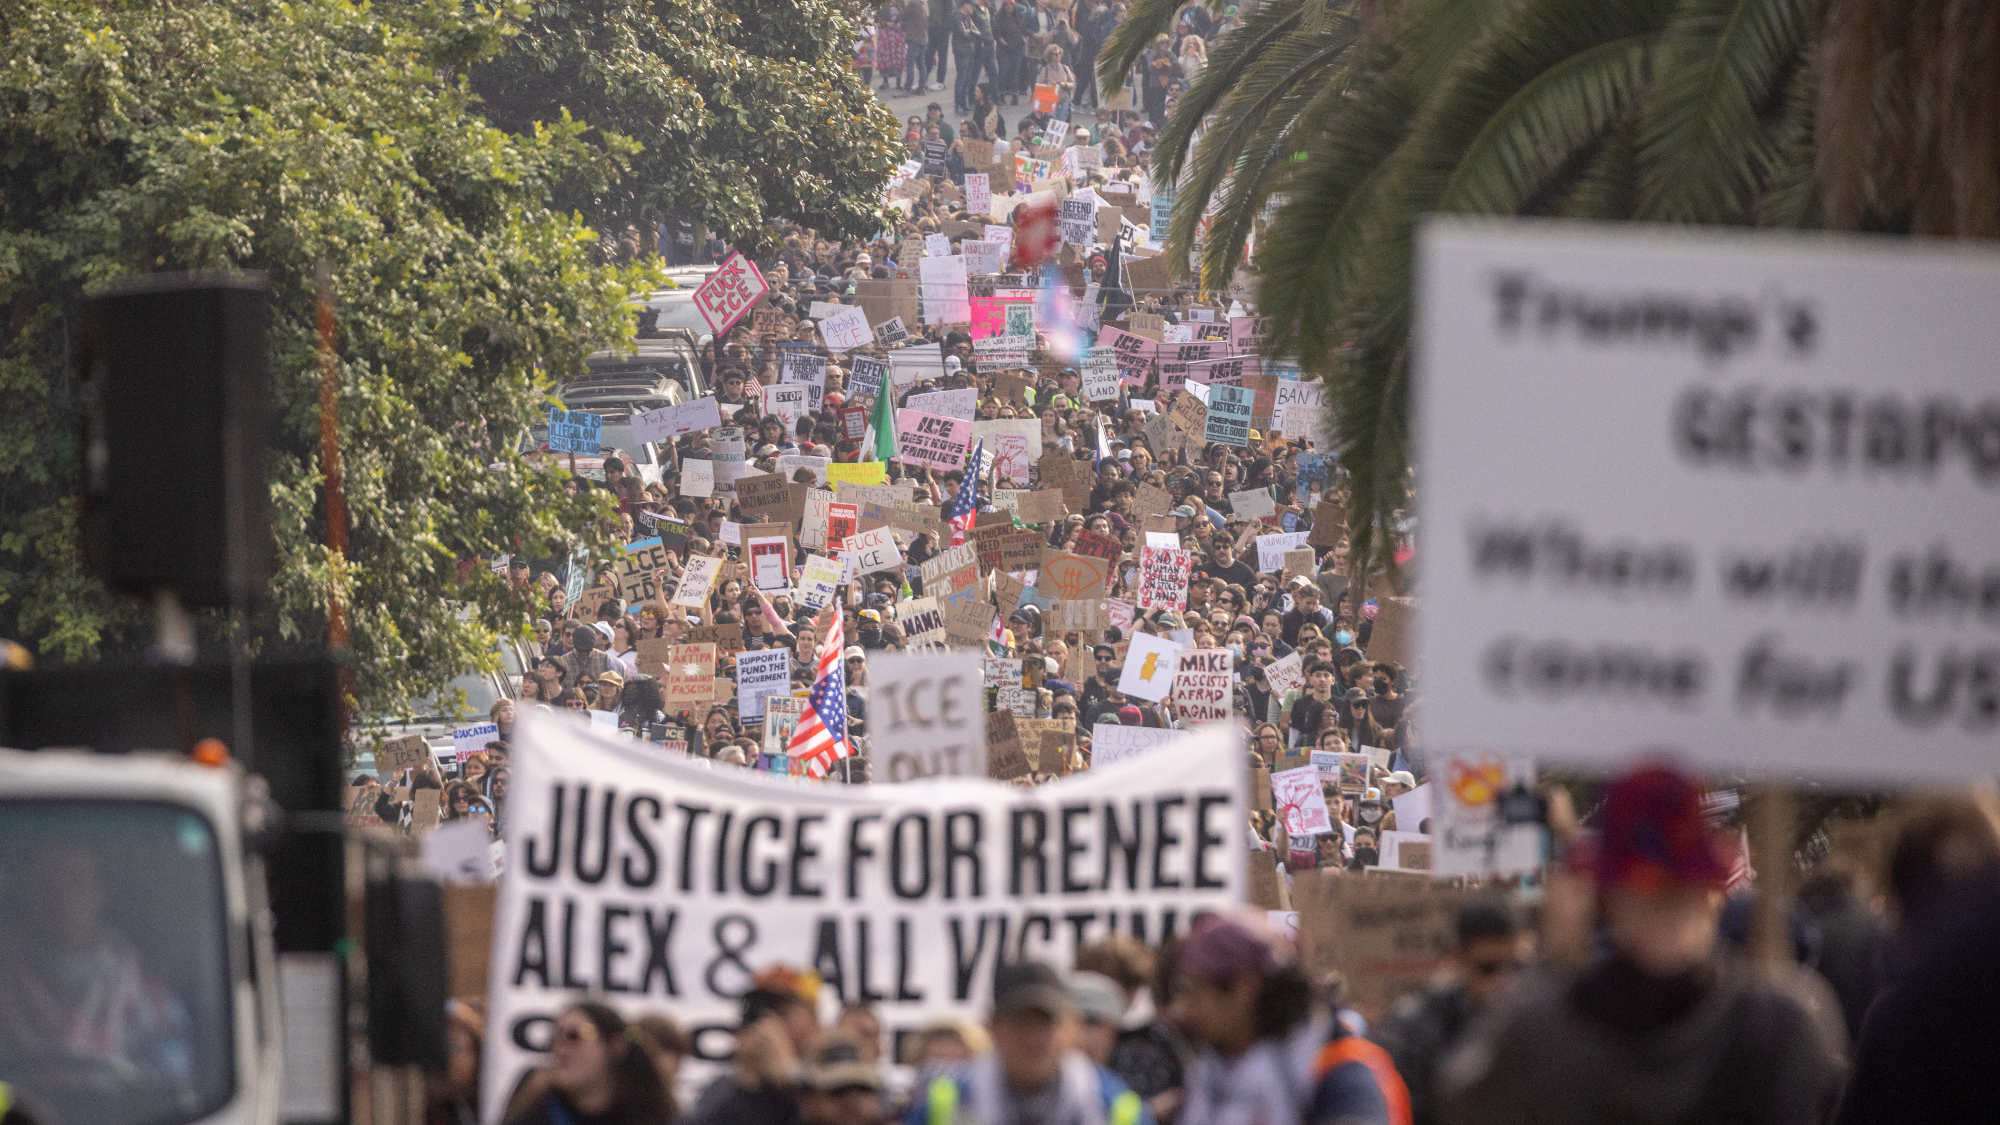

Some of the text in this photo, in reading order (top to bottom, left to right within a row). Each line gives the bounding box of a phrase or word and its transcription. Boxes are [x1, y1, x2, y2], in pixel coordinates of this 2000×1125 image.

[1015, 156, 1049, 178] FUCK
[967, 175, 987, 186] THIS
[972, 185, 980, 193] IS
[968, 193, 989, 201] STATE
[967, 203, 991, 212] VIOLENCE
[1063, 200, 1092, 215] DEFEND
[1062, 211, 1091, 222] DEMOCRACY:
[1062, 223, 1073, 231] IT'S
[1073, 223, 1084, 232] TIME
[1068, 237, 1086, 245] STRIKE!
[1069, 230, 1088, 239] GENERAL
[965, 244, 996, 255] ABOLISH
[965, 257, 983, 266] ICE
[700, 260, 746, 311] FUCK
[713, 279, 753, 325] ICE
[754, 311, 782, 323] FUCK
[1487, 266, 1817, 366] Trump's
[758, 322, 783, 333] ICE
[825, 314, 860, 337] Abolish
[885, 321, 901, 334] OUT
[1132, 316, 1150, 330] FUCK
[887, 330, 907, 343] GOOD!
[1196, 325, 1230, 340] ICE
[833, 327, 865, 352] ICE
[1008, 337, 1016, 345] DO
[1114, 333, 1145, 354] ICE
[786, 353, 825, 366] IT'S TIME FOR
[1177, 346, 1211, 361] ICE
[793, 364, 820, 375] GENERAL
[854, 358, 887, 378] DEFEN
[1084, 358, 1112, 370] ILLEGAL
[1208, 361, 1243, 380] ICE
[792, 371, 816, 382] STRIKE!
[1085, 374, 1117, 386] STOLEN
[849, 381, 874, 394] IT'S TIME
[1089, 386, 1116, 398] LAND
[776, 391, 802, 402] STOP
[910, 395, 937, 405] JESUS
[1278, 387, 1308, 405] BAN
[1210, 401, 1251, 416] JUSTICE FOR
[551, 408, 602, 428] NO ONE IS
[1208, 416, 1249, 428] RENEE
[550, 423, 597, 441] ILLEGAL ON
[916, 416, 955, 438] ICE
[1206, 424, 1248, 438] NICOLE GOOD
[899, 431, 966, 454] DESTROYS
[1671, 384, 2000, 488] GESTAPO
[551, 437, 601, 455] STOLEN LAND
[900, 444, 961, 465] FAMILIES
[738, 484, 758, 496] FUCK
[762, 479, 782, 491] THIS
[757, 490, 789, 507] BULLSHIT!
[855, 490, 894, 501] PRISON
[994, 491, 1017, 500] ENOU
[895, 499, 921, 513] HATE
[657, 519, 689, 536] EXISTENCE
[832, 519, 851, 529] JAIL
[834, 528, 848, 538] ICE
[845, 531, 883, 553] FUCK
[976, 539, 1000, 552] NEED
[1023, 542, 1040, 550] DUE
[753, 544, 783, 556] STOP
[1003, 550, 1036, 559] PROCESS
[618, 546, 667, 578] ICE
[858, 551, 884, 570] ICE
[922, 561, 939, 584] OPEN
[938, 549, 958, 574] YOUR
[957, 541, 976, 569] EYES
[1156, 553, 1171, 565] NO
[1468, 517, 1698, 586] When
[1722, 536, 1866, 606] will
[1145, 563, 1180, 573] HUMAN
[938, 574, 952, 597] WAS
[952, 567, 978, 592] MURDER
[1144, 580, 1183, 590] ON STOLEN
[588, 590, 610, 600] THE
[626, 581, 656, 605] ID
[804, 592, 826, 604] ICE
[1149, 591, 1177, 601] LAND
[961, 601, 993, 619] FIGHT
[688, 628, 719, 641] FUCK
[672, 652, 713, 664] ANTIFA
[739, 653, 786, 666] SUPPORT &
[1179, 653, 1228, 673] MAKE
[741, 663, 786, 675] FUND THE
[1267, 664, 1280, 675] WE
[1268, 661, 1302, 683] PROTECT
[1484, 638, 1706, 714] come
[1738, 634, 1858, 716] for
[740, 672, 787, 685] MOVEMENT
[1176, 674, 1229, 688] FASCISTS
[1277, 676, 1289, 686] US
[671, 684, 713, 694] FASCISM
[1000, 689, 1026, 699] STOP
[1177, 689, 1224, 705] AFRAID
[770, 697, 806, 713] MELT
[880, 676, 966, 732] ICE
[1178, 705, 1227, 720] AGAIN
[453, 725, 498, 739] EDUCATION
[1029, 721, 1047, 730] UPPER
[665, 728, 685, 738] ICE
[1117, 729, 1152, 747] USES
[382, 739, 410, 754] MELT
[394, 749, 421, 766] ICE!
[765, 753, 811, 774] TINY
[523, 780, 826, 899] JUSTICE
[846, 811, 985, 899] FOR
[1009, 793, 1231, 896] RENEE
[513, 898, 1180, 1000] ALEX & ALL VICTIM
